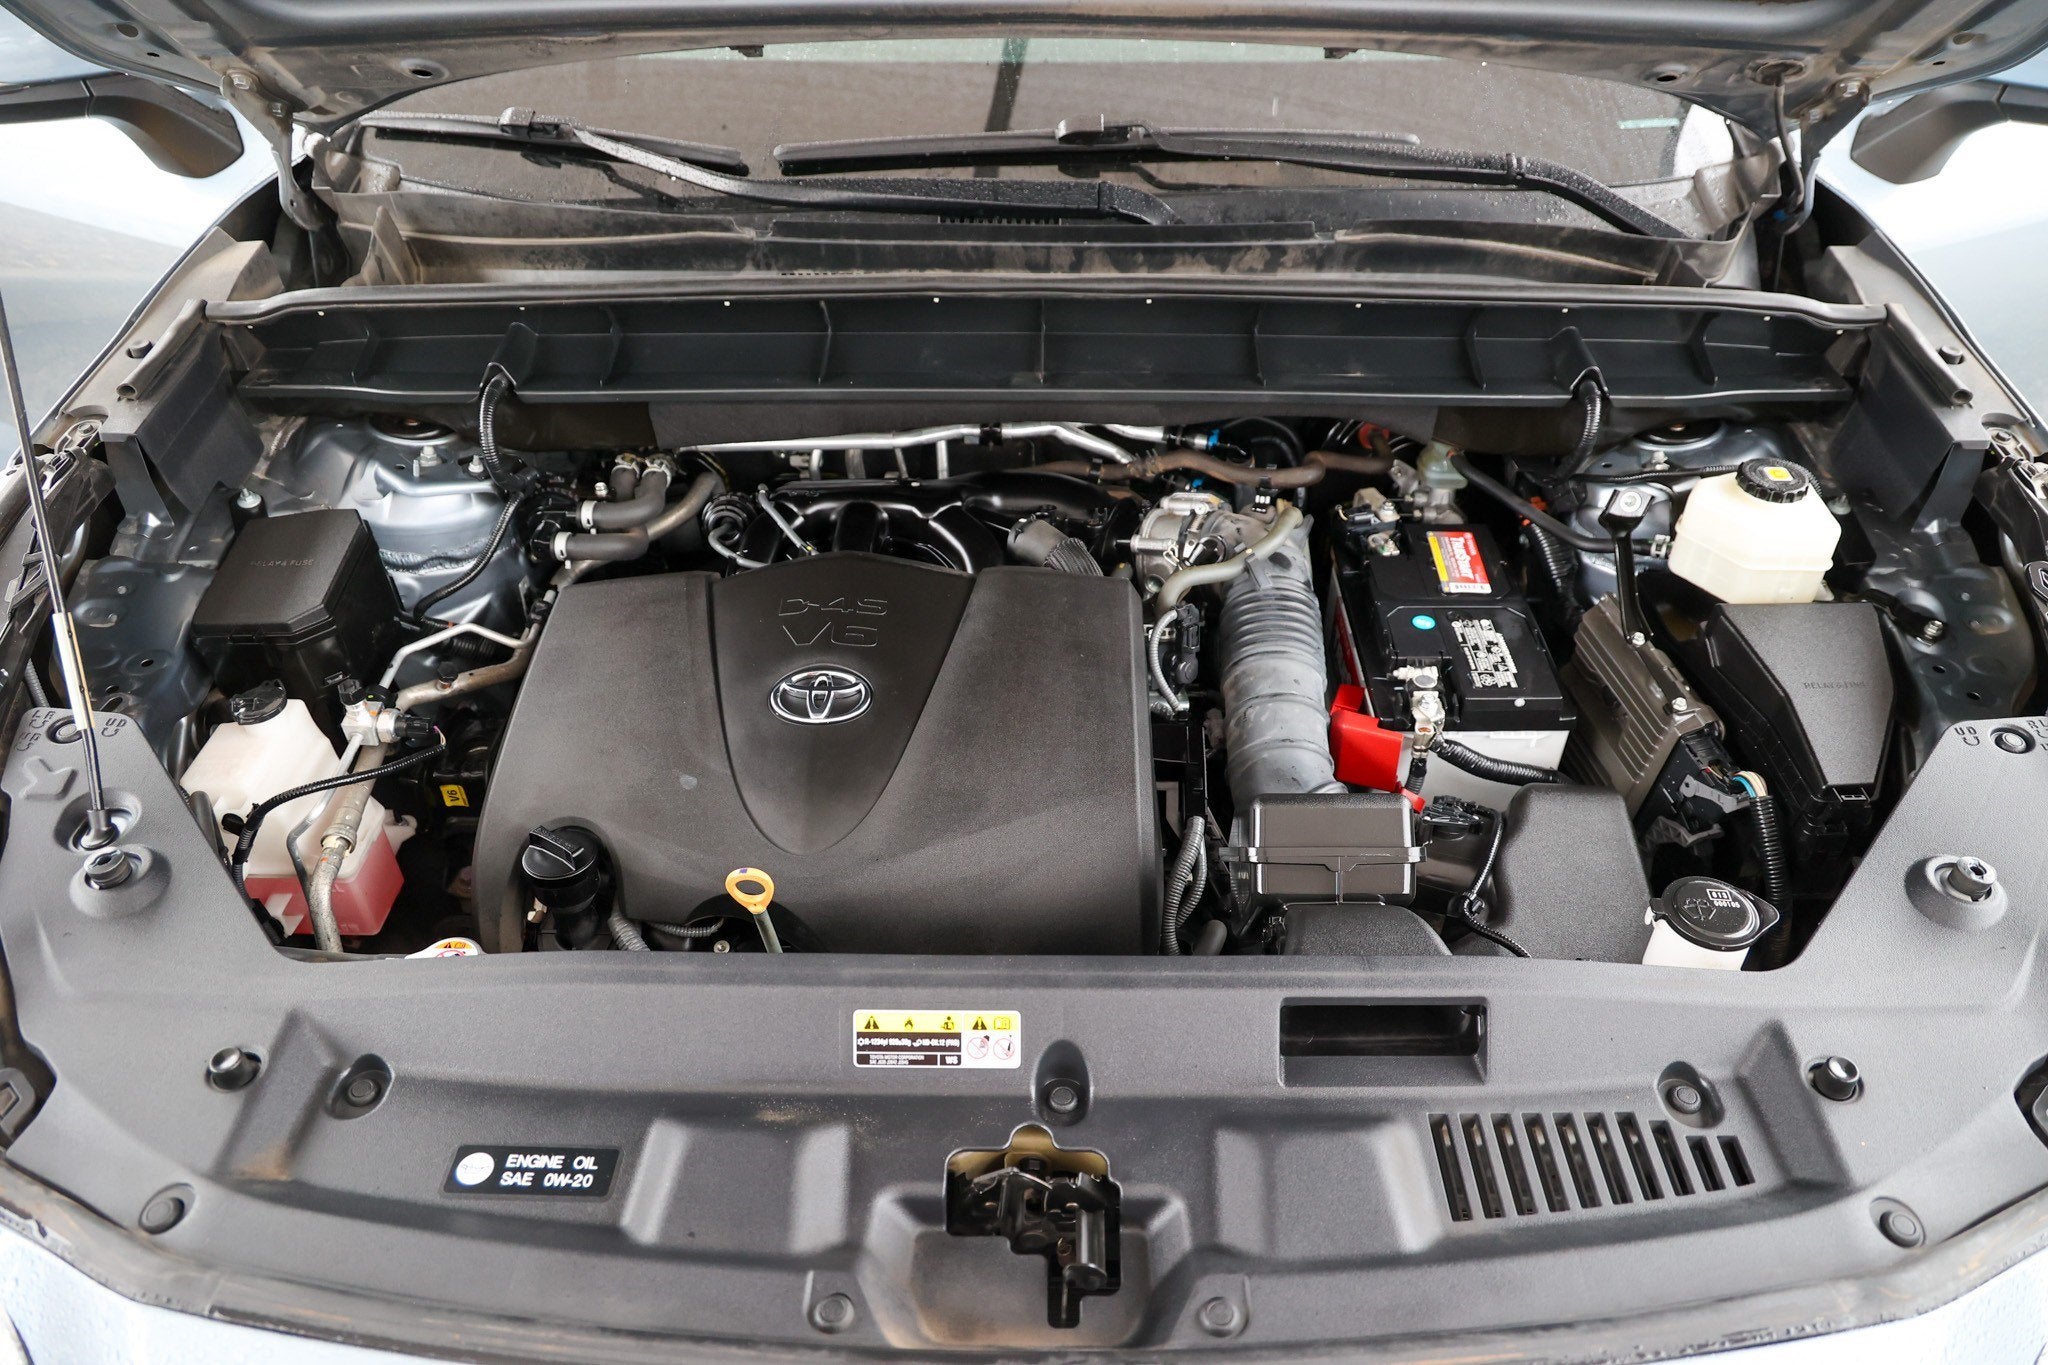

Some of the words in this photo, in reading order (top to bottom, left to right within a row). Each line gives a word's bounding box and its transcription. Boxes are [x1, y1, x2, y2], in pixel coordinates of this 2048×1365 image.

[778, 598, 888, 616] D-4S
[782, 622, 878, 647] V6
[505, 1153, 566, 1169] ENGINE
[572, 1155, 600, 1170] OIL
[499, 1171, 535, 1186] SAE
[543, 1173, 595, 1188] 0W-20
